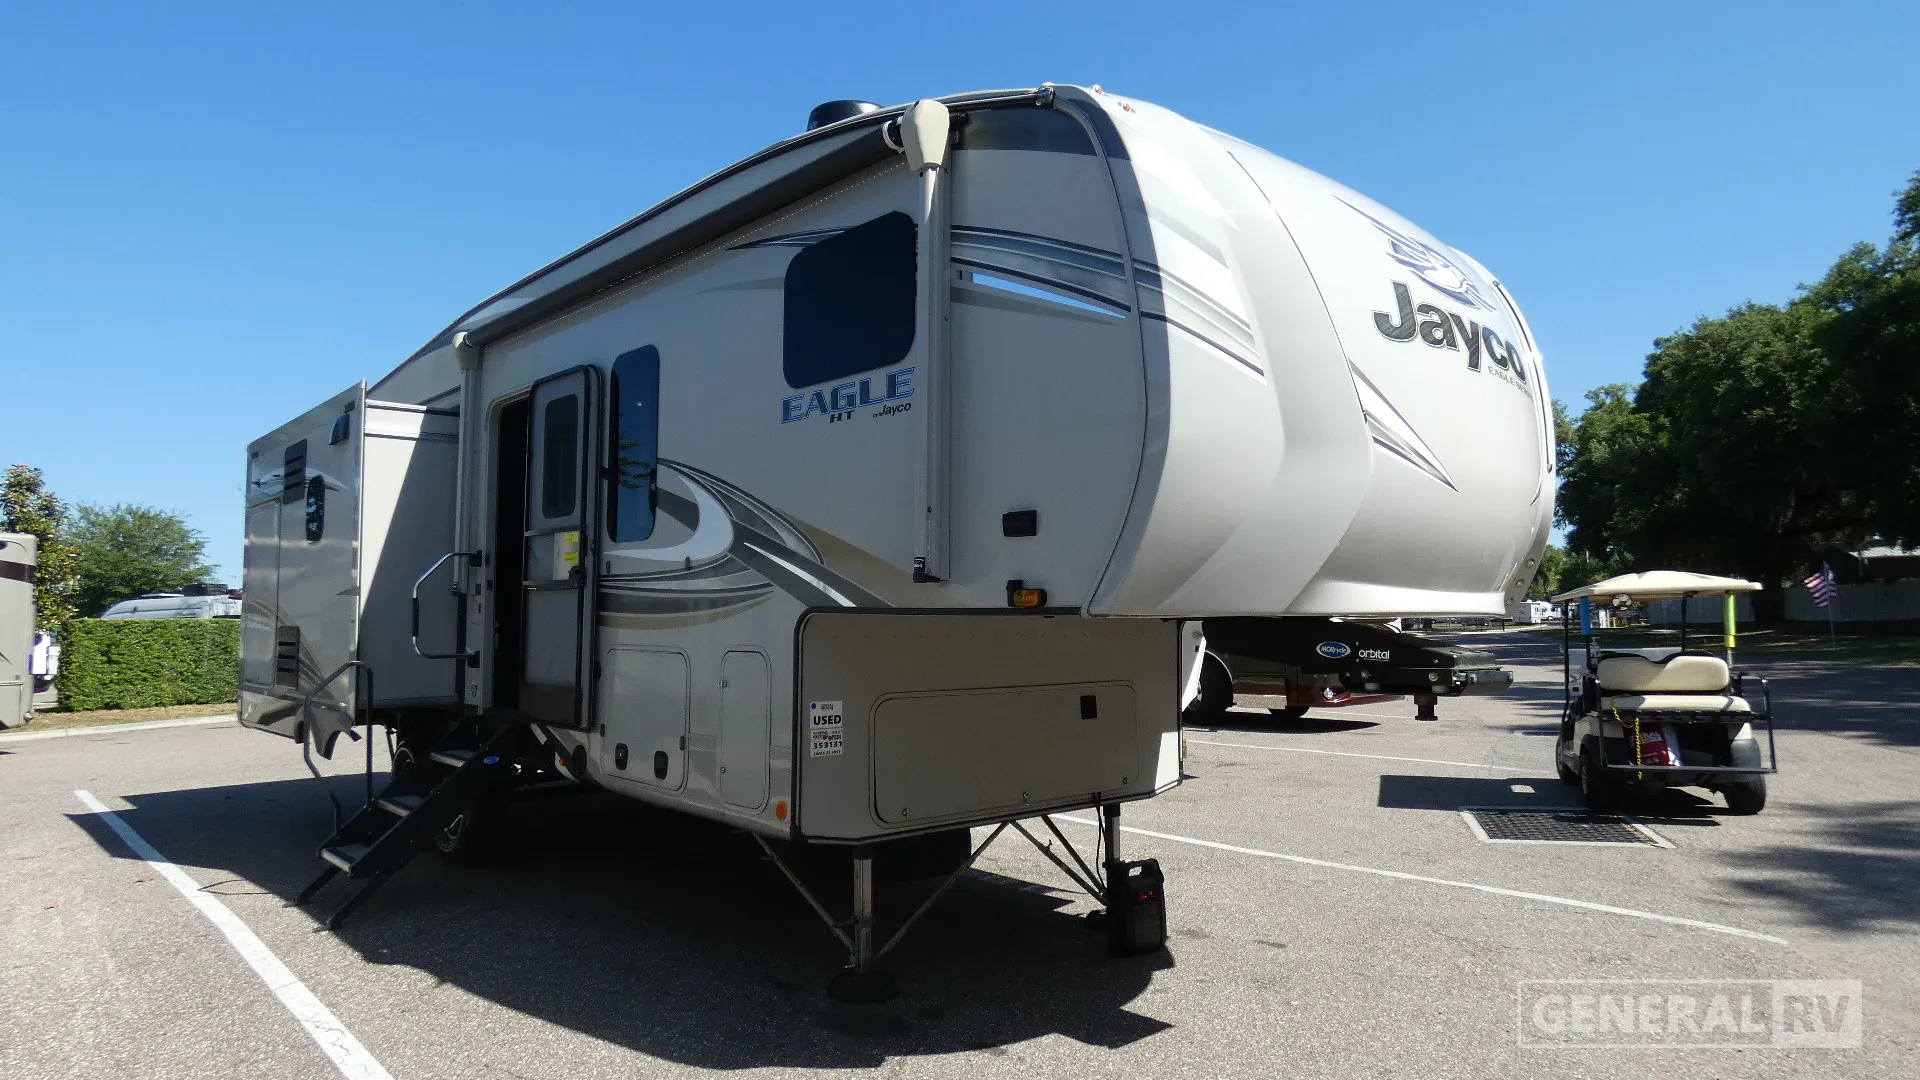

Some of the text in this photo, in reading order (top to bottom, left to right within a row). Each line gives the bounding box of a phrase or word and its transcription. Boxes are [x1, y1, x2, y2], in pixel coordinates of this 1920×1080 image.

[1372, 279, 1527, 384] Jayco
[1488, 366, 1515, 386] EAGLE
[781, 367, 915, 424] EAGLE
[829, 410, 856, 423] HT
[879, 403, 912, 417] Jayco
[1359, 649, 1390, 660] orbital
[813, 715, 841, 725] USED
